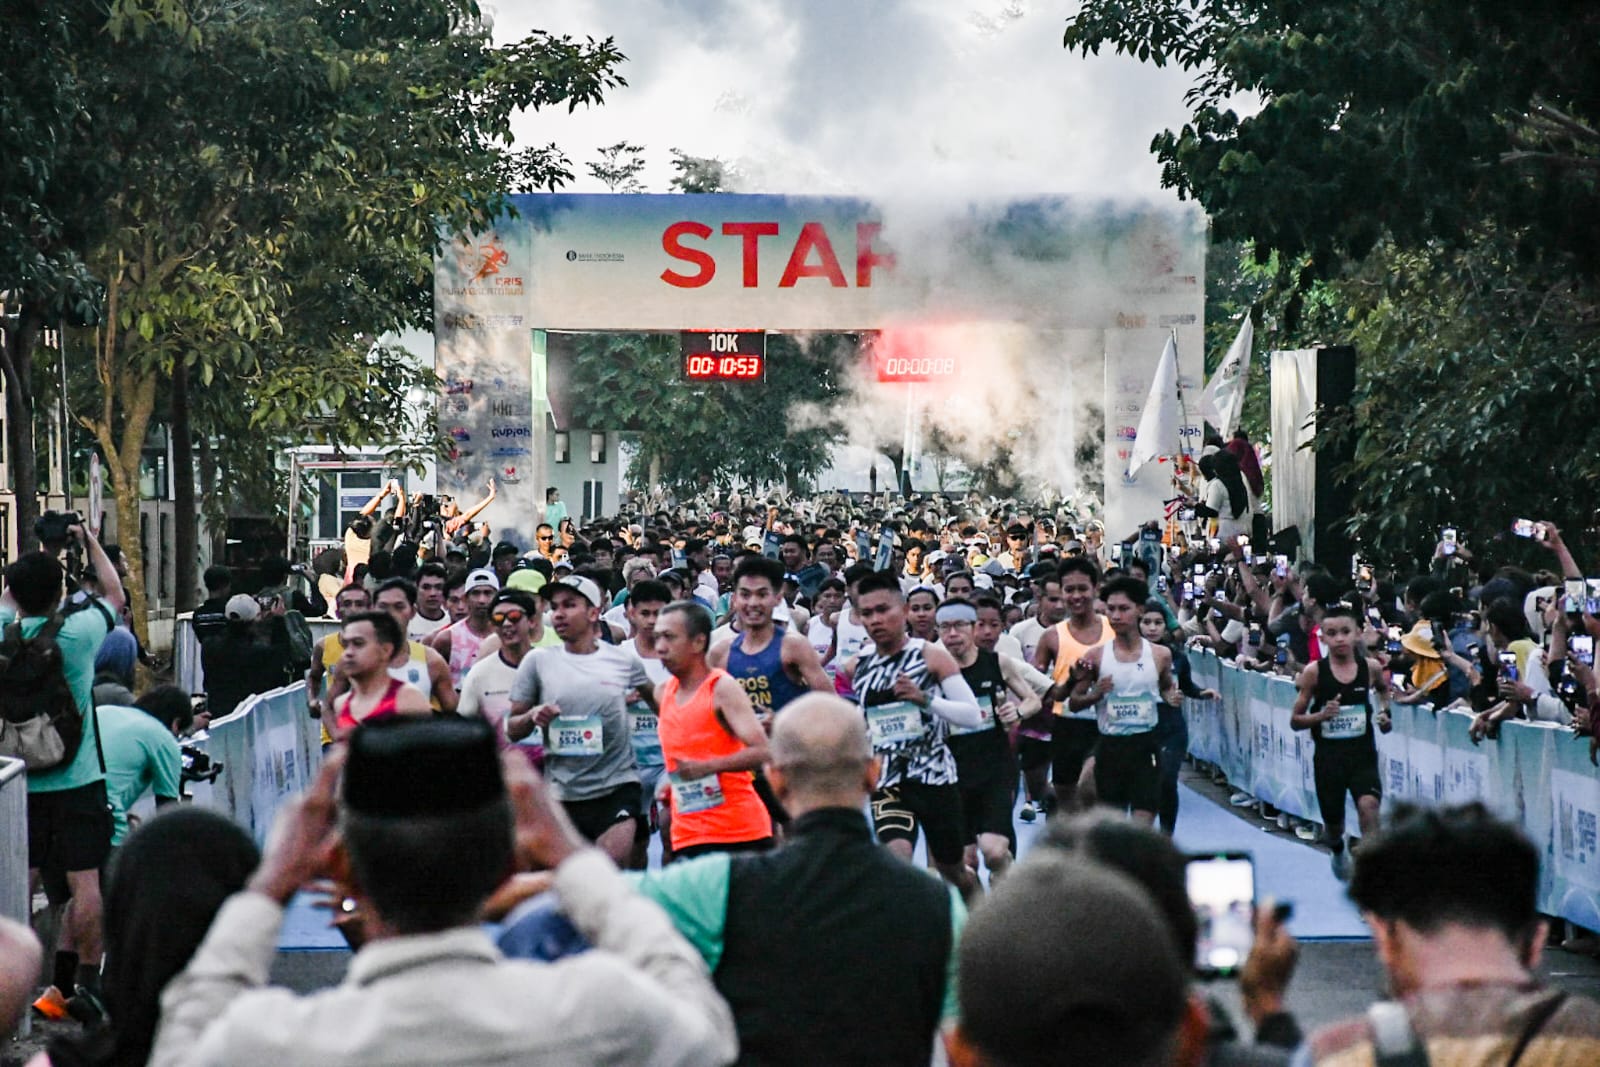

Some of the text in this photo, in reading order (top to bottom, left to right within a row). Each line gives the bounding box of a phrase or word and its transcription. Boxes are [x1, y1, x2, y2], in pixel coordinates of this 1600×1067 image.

[659, 220, 897, 289] STAR
[708, 333, 739, 352] 10K
[886, 358, 954, 375] 00:00:08
